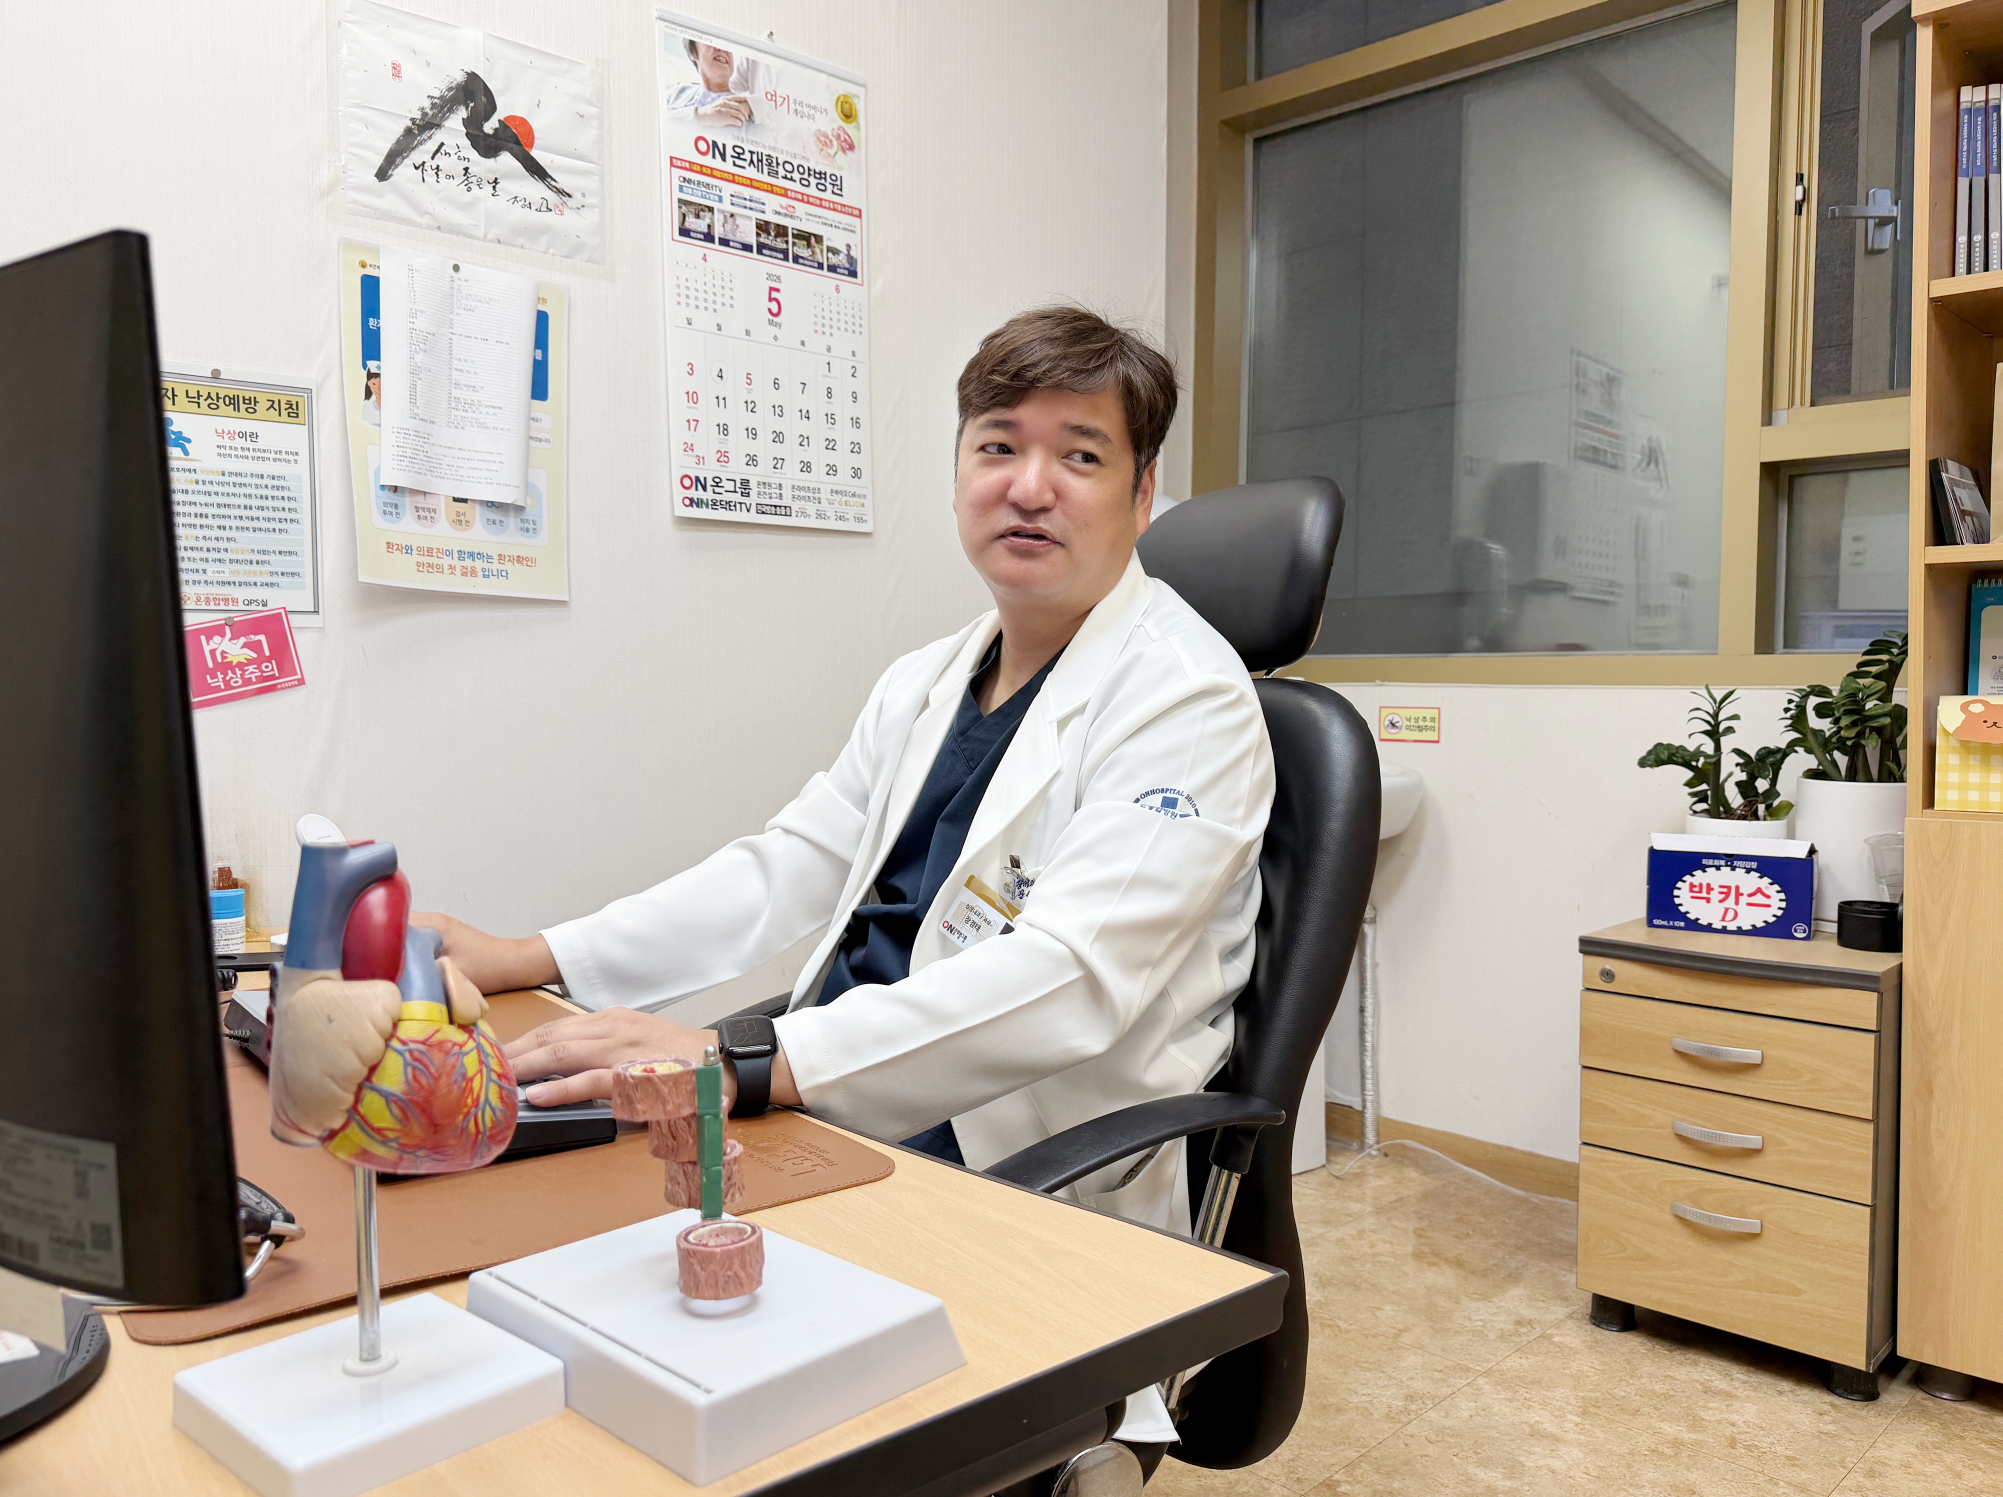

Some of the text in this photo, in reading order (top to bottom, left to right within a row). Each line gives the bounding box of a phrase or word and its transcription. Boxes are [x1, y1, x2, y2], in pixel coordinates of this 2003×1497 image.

[765, 90, 791, 115] 여기
[431, 141, 470, 164] 새해
[694, 135, 727, 163] ON
[730, 144, 844, 198] 온재활요양병원
[456, 166, 483, 193] 좋은
[487, 177, 501, 197] 날
[702, 253, 707, 263] 4
[765, 272, 782, 284] 2026
[835, 284, 841, 294] 6
[767, 286, 783, 318] 5
[768, 318, 783, 330] May
[686, 317, 693, 327] 일
[716, 322, 723, 332] 월
[772, 334, 779, 343] 수
[826, 345, 832, 353] 금
[826, 361, 857, 378] 1 2
[687, 362, 857, 403] 3 4 5 6 7 8 9
[185, 389, 260, 415] 낙상예방
[265, 399, 300, 419] 지침
[685, 391, 861, 429] 10 11 12 13 14 15 16
[215, 428, 260, 443] 낙상이란
[686, 418, 861, 455] 17 18 19 20 21 22 23
[683, 442, 862, 480] 24 25 26 27 28 29 30
[695, 455, 706, 466] 31
[680, 473, 752, 498] ON 온그룹
[382, 501, 399, 510] 의약품
[414, 505, 437, 515] 혈액제제
[682, 496, 752, 513] ONN 온닥터TV
[382, 509, 401, 519] 투여 전
[417, 514, 429, 522] 투여
[452, 518, 470, 527] 시행 전
[455, 510, 467, 518] 검사
[486, 518, 504, 527] 진료 전
[519, 526, 537, 535] 시술 전
[385, 541, 537, 568] 환자와 의료진이 함께하는 환자확인!
[416, 560, 509, 580] 안전의 첫 걸음 입니다
[194, 596, 268, 608] 온종합병원 QPS실
[206, 660, 279, 689] 낙상주의
[1139, 788, 1197, 808] ONHOSPITAL 2010
[1701, 858, 1758, 869] 피로회복 자양강장
[1688, 881, 1772, 908] 박카스
[1719, 906, 1739, 923] D
[942, 920, 955, 934] ON
